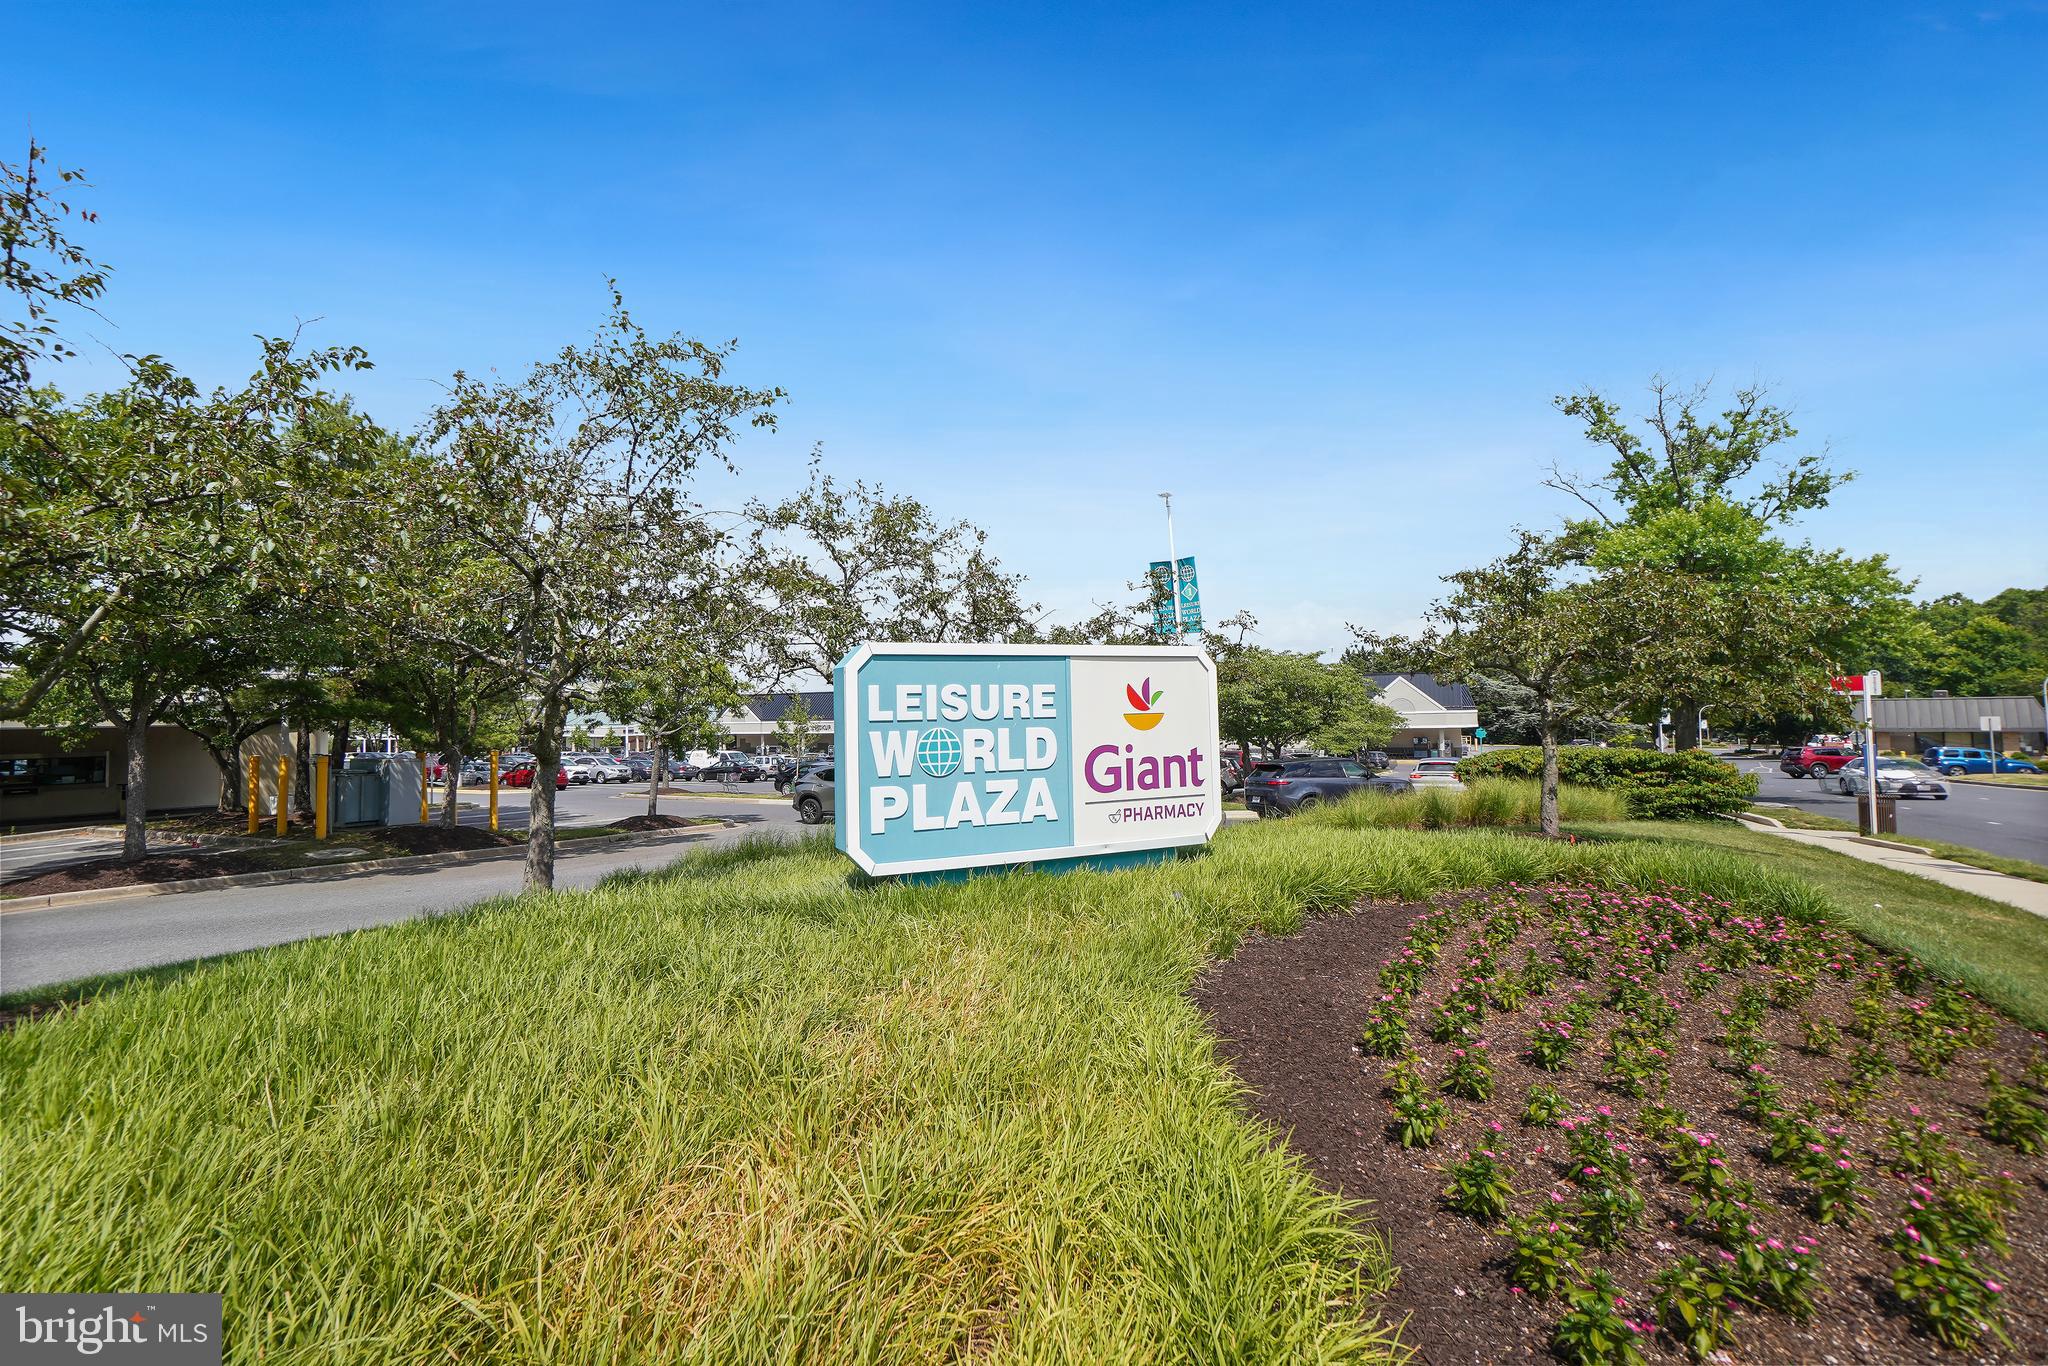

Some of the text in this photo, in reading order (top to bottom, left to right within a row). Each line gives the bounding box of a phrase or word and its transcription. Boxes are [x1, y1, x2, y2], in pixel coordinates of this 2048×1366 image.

[868, 684, 1057, 722] LEISURE
[1084, 743, 1206, 794] Giant
[869, 777, 1059, 835] PLAZA
[1123, 802, 1205, 823] PHARMACY
